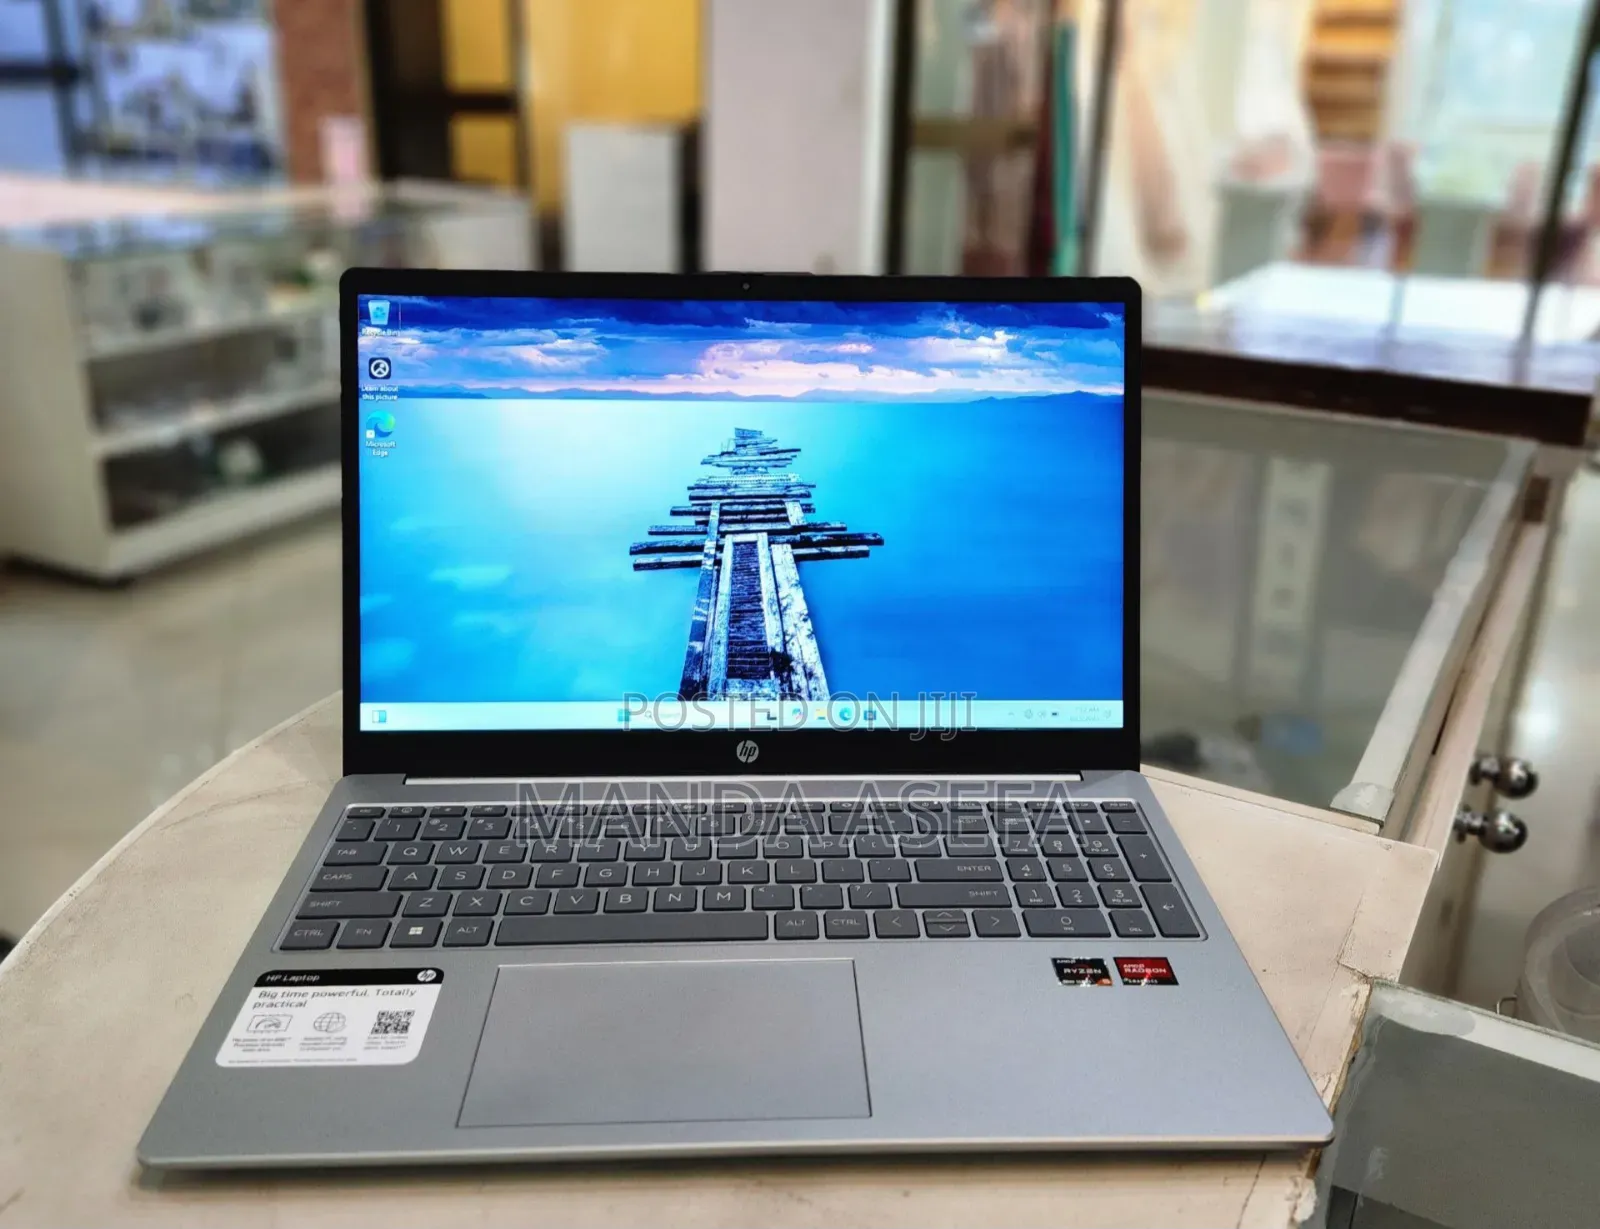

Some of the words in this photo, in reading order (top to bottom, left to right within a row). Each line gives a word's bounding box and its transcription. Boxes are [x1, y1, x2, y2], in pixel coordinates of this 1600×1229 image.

[361, 385, 379, 393] Learn
[379, 385, 399, 393] about
[362, 393, 375, 401] this
[375, 393, 398, 402] picture
[365, 440, 396, 449] Microsoft
[372, 449, 389, 457] Edge
[737, 740, 759, 763] hp
[437, 823, 449, 831] 2
[484, 823, 494, 831] 3
[685, 843, 697, 851] U
[822, 841, 833, 849] P
[1011, 840, 1021, 848] 7
[1092, 840, 1102, 848] 9
[403, 847, 418, 856] Q
[449, 846, 468, 855] W
[499, 846, 511, 854] E
[546, 845, 557, 854] R
[696, 867, 706, 876] J
[741, 866, 754, 875] K
[790, 865, 799, 874] L
[1021, 864, 1031, 872] 4
[1062, 864, 1072, 872] 5
[1103, 863, 1113, 872] 6
[404, 872, 418, 881] A
[454, 871, 467, 880] S
[502, 870, 516, 879] D
[552, 869, 564, 878] F
[599, 868, 613, 878] G
[647, 868, 660, 877] H
[668, 893, 682, 902] N
[716, 892, 731, 901] M
[1032, 889, 1038, 897] 1
[1072, 889, 1083, 898] 2
[1114, 889, 1125, 898] 3
[419, 898, 433, 907] Z
[469, 897, 484, 906] X
[520, 896, 534, 905] C
[570, 895, 584, 904] V
[619, 894, 632, 904] B
[308, 900, 342, 908] SHIFT
[785, 919, 806, 927] ALT
[294, 929, 323, 937] CTRL
[456, 926, 479, 934] ALT
[265, 974, 281, 982] HP
[282, 974, 320, 983] Laptop
[416, 969, 437, 982] hp
[258, 990, 277, 1000] Big
[280, 990, 309, 999] time
[310, 989, 370, 1000] powerful.
[375, 988, 417, 998] Totally
[252, 1000, 307, 1010] practical
